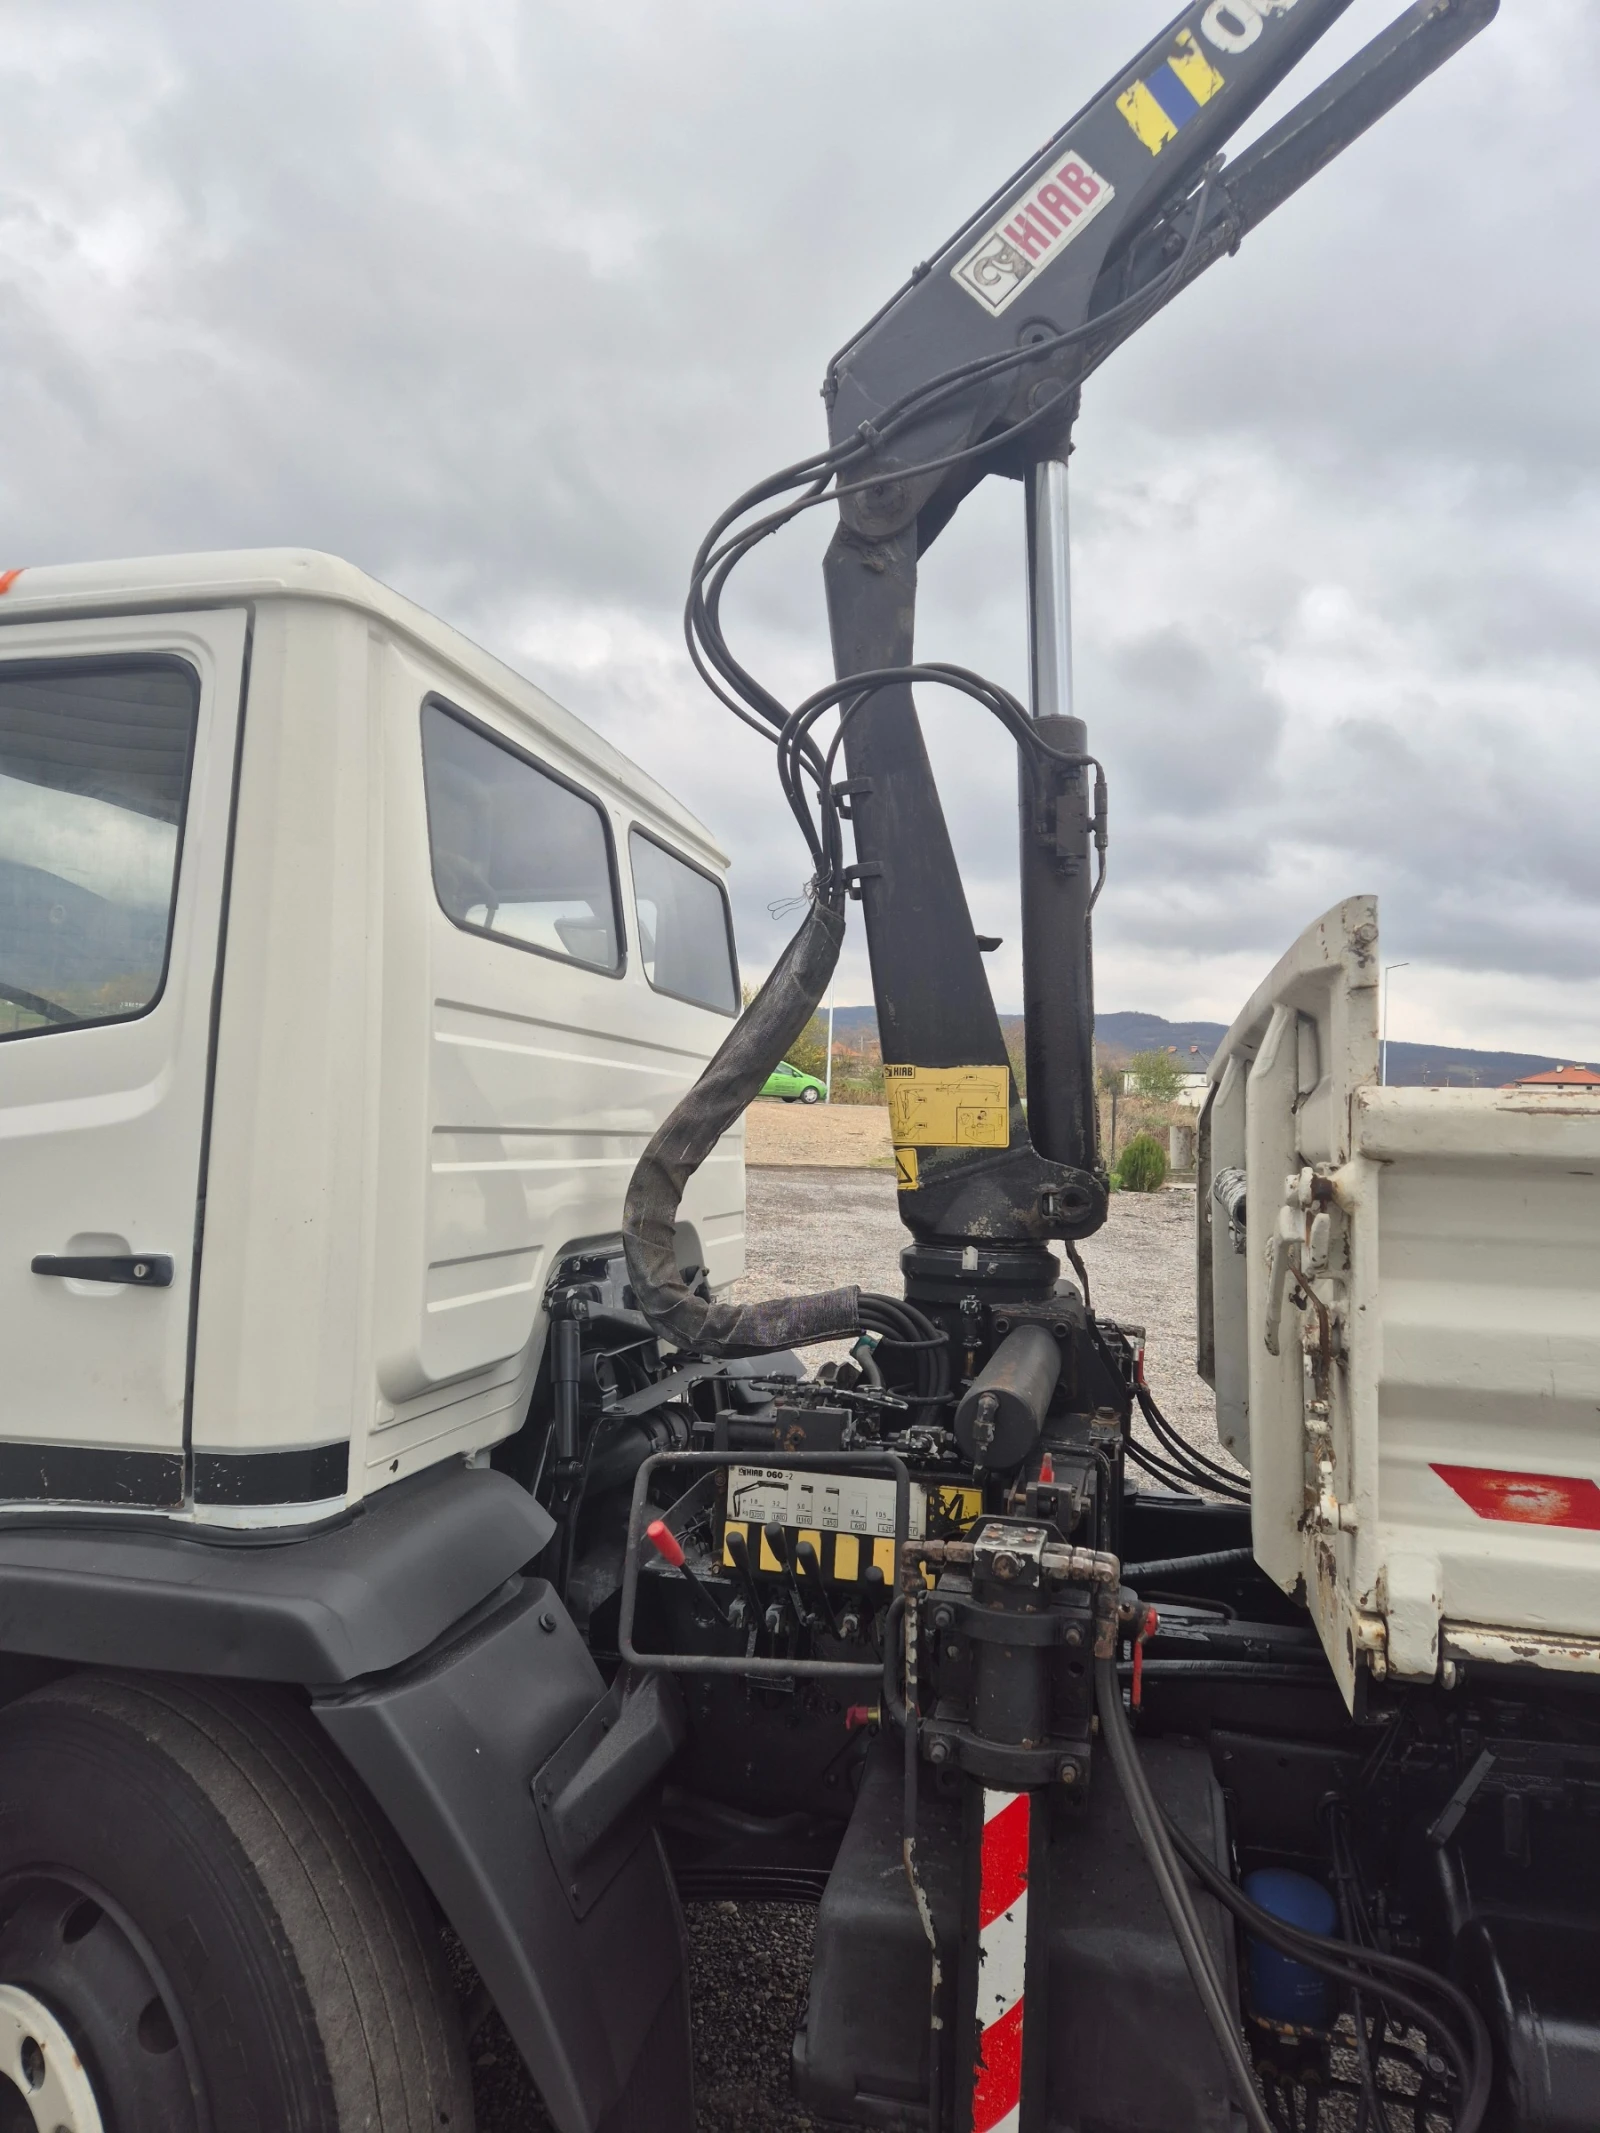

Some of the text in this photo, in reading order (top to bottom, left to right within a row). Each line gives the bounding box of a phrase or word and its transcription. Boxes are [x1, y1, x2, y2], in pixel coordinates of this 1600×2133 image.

[1003, 161, 1101, 260] HIAB
[893, 1066, 914, 1077] HIAB
[745, 1468, 763, 1477] HIAB
[766, 1471, 783, 1479] 060
